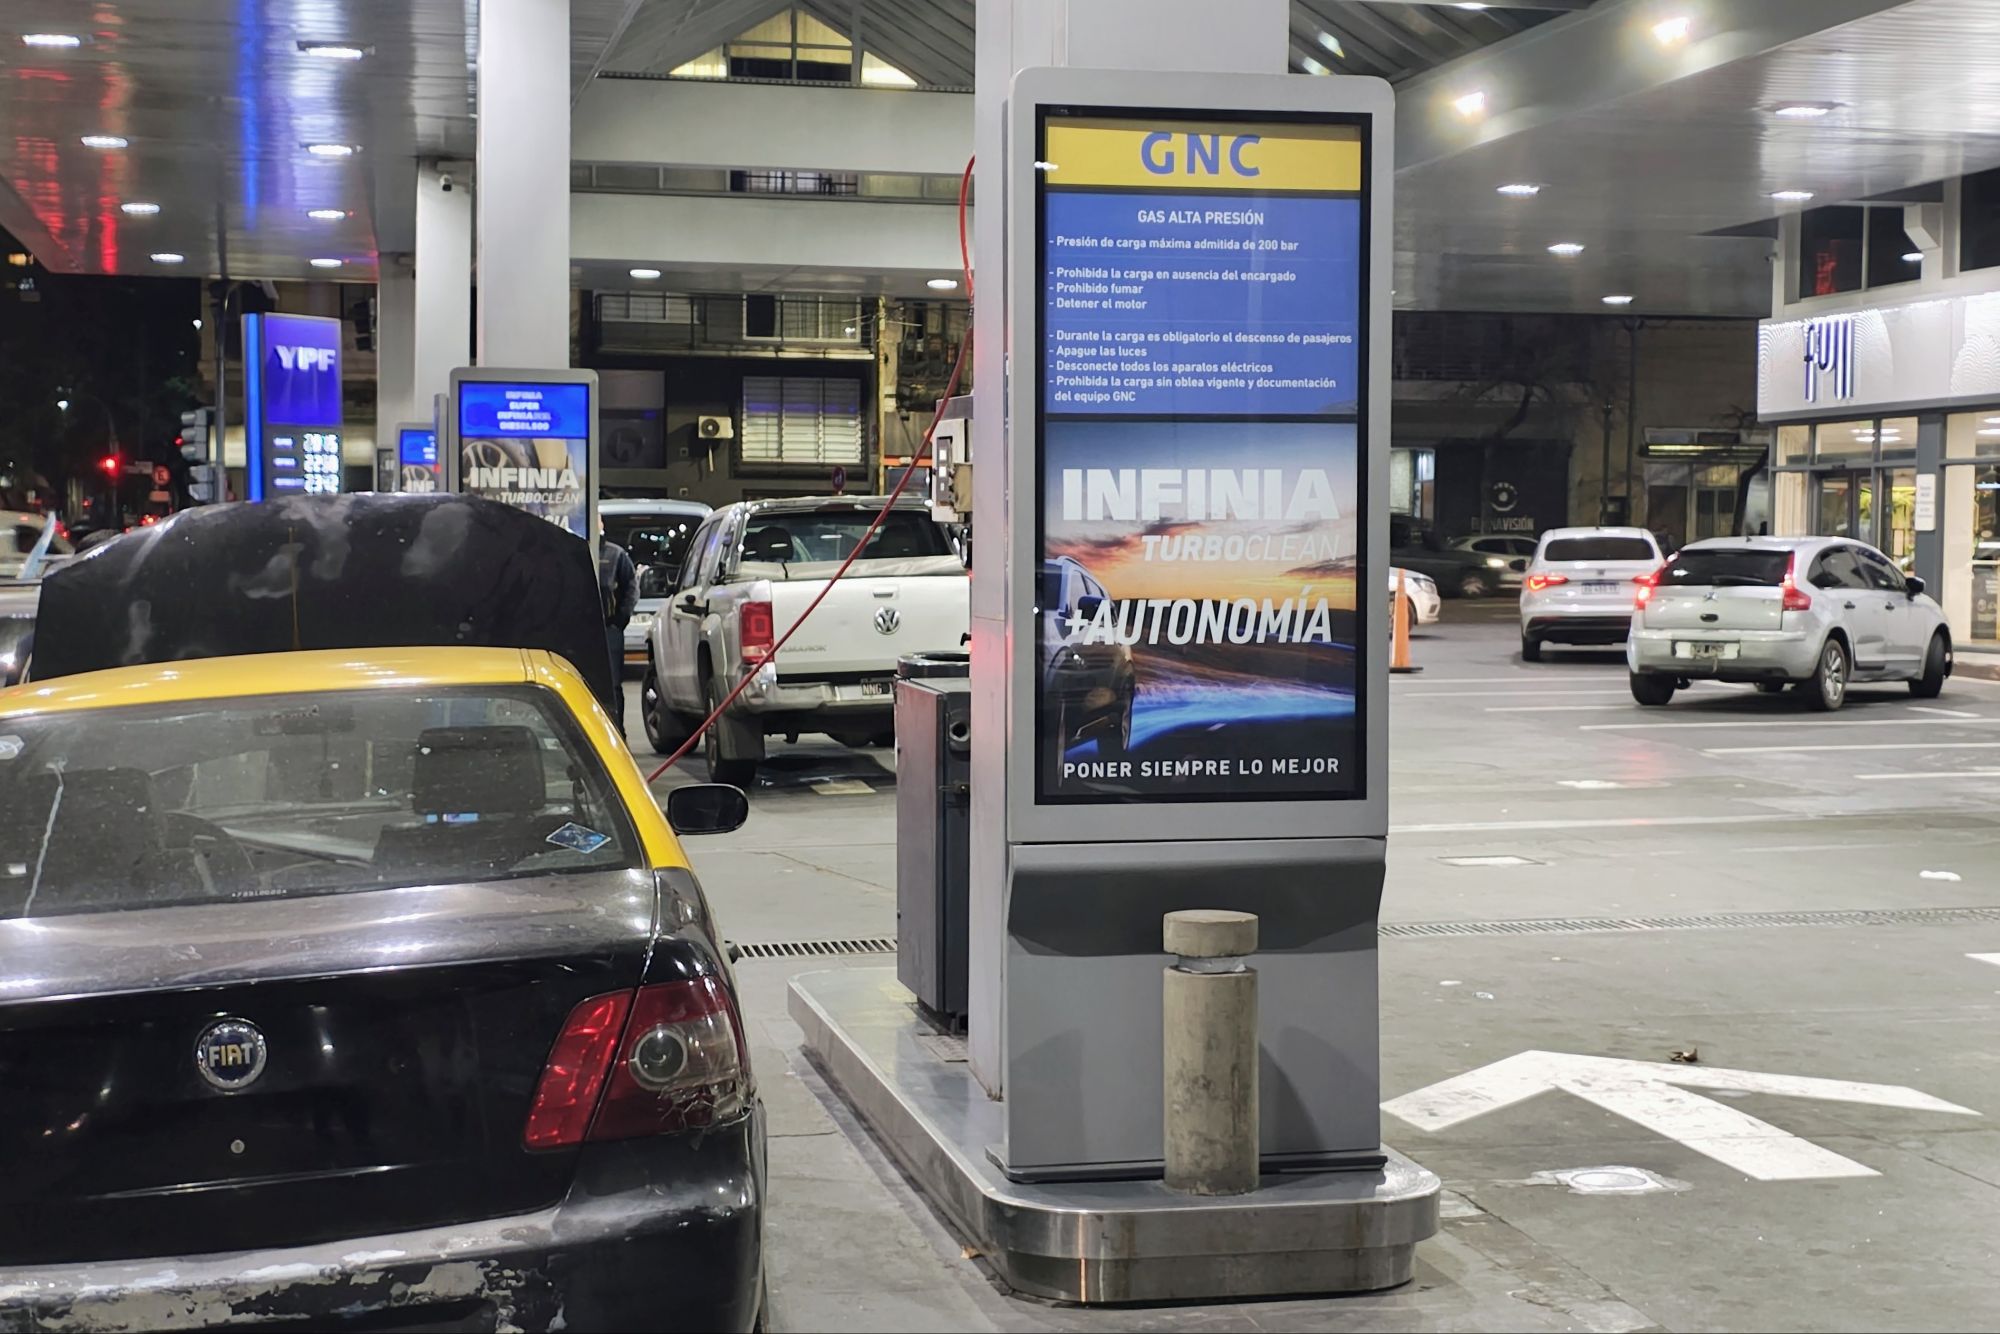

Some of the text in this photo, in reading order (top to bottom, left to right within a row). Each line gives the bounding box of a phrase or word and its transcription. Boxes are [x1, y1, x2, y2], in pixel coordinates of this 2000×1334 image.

[1141, 131, 1261, 177] GNC
[1138, 209, 1264, 225] GAS ALTA PRESIÓN
[1056, 236, 1098, 247] Presión
[1100, 237, 1114, 247] de
[1116, 240, 1146, 250] carga
[1149, 238, 1191, 249] máxima
[1194, 239, 1240, 249] admitida
[1243, 240, 1256, 250] de
[1258, 240, 1278, 250] 200
[1280, 240, 1299, 250] bar
[1056, 267, 1108, 278] Prohibida
[1111, 268, 1120, 278] la
[1123, 271, 1153, 281] carga
[1156, 272, 1169, 280] en
[1172, 269, 1219, 280] ausencia
[1221, 270, 1238, 280] del
[1240, 271, 1296, 283] encargado
[1056, 282, 1108, 293] Prohibido
[1111, 283, 1144, 294] fumar
[1056, 298, 1099, 308] Detener
[1102, 299, 1112, 309] el
[1115, 300, 1147, 309] motor
[1056, 330, 1099, 340] Durante
[1102, 330, 1112, 341] la
[1115, 333, 1145, 343] carga
[1147, 333, 1160, 341] es
[1162, 332, 1220, 344] obligatorio
[1222, 332, 1232, 342] el
[1235, 332, 1285, 343] descenso
[1287, 333, 1301, 343] de
[1303, 333, 1352, 345] pasajeros
[276, 345, 336, 371] YPF
[1056, 345, 1097, 358] Apague
[1100, 346, 1116, 356] las
[1118, 346, 1147, 357] luces
[1056, 360, 1118, 371] Desconecte
[1121, 361, 1150, 371] todos
[1153, 361, 1169, 372] los
[1172, 363, 1218, 373] aparatos
[1221, 361, 1273, 373] eléctricos
[1056, 375, 1108, 386] Prohibida
[1111, 376, 1121, 386] la
[1123, 379, 1153, 389] carga
[1156, 376, 1172, 387] sin
[1175, 377, 1204, 387] oblea
[1207, 378, 1246, 389] vigente
[1248, 380, 1254, 390] y
[1256, 377, 1336, 388] documentación
[1054, 391, 1136, 403] del equipo GNC
[470, 467, 580, 489] INFINIA
[500, 491, 580, 504] TURBOCLEAN
[1063, 468, 1340, 521] INFINIA
[1142, 534, 1341, 562] TURBOCLEAN
[1064, 585, 1332, 646] +AUTONOMÍA
[1063, 757, 1339, 779] PONER SIEMPRE LO MEJOR
[208, 1042, 253, 1068] FIAT
